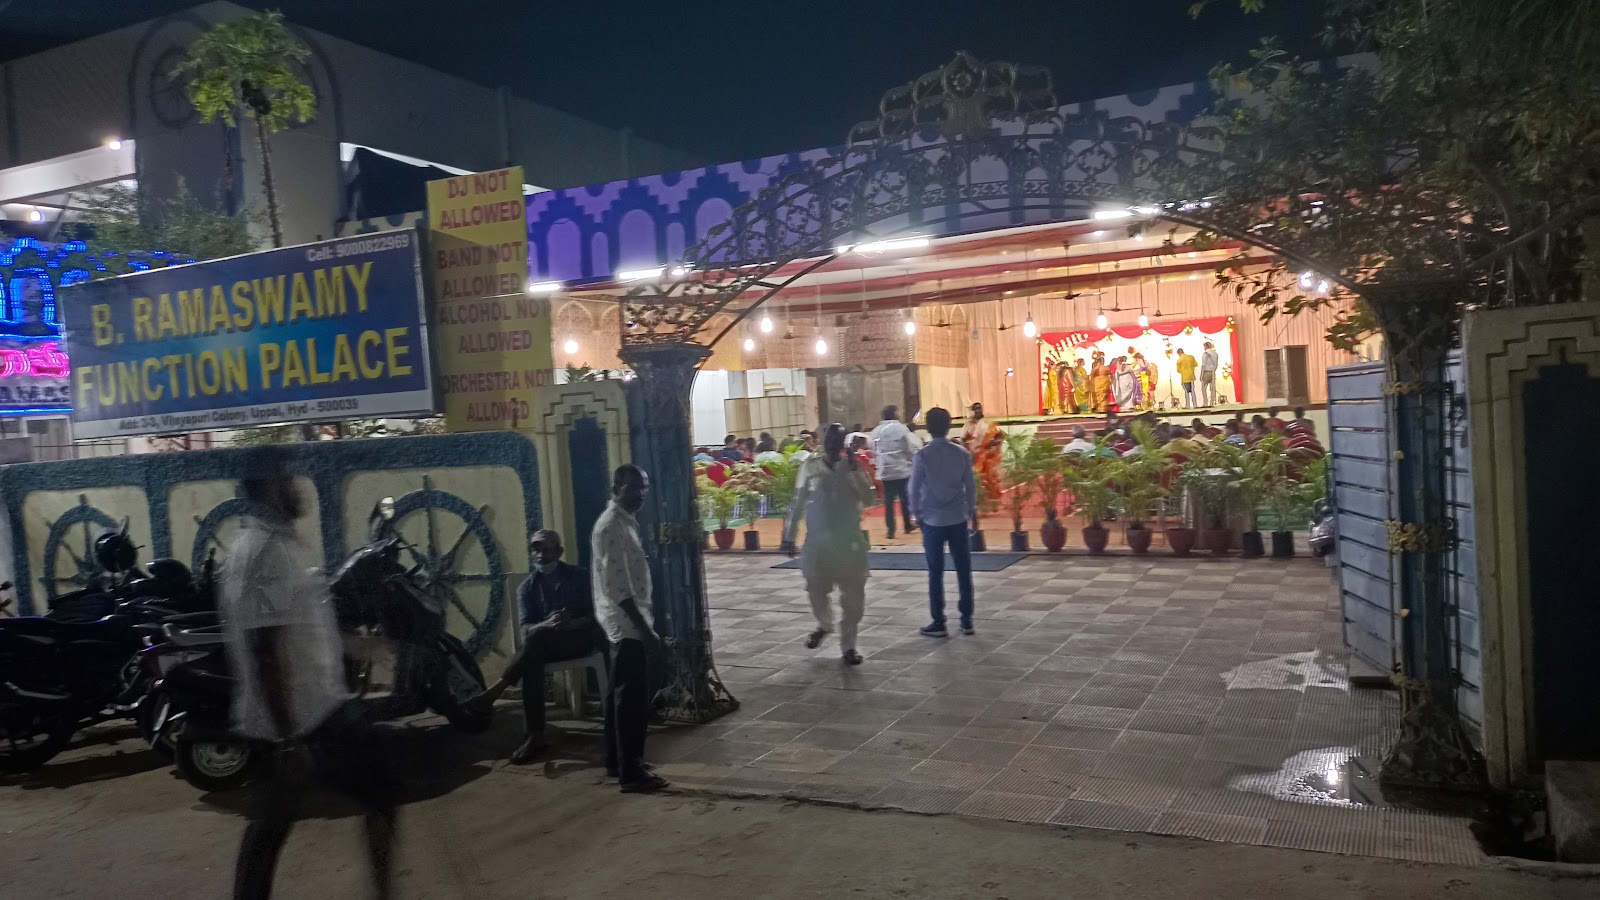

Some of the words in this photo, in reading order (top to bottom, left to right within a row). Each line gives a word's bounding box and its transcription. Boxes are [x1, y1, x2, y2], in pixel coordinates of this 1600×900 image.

[447, 177, 468, 199] DJ
[474, 170, 509, 195] NOT
[440, 199, 522, 230] ALLOWED
[437, 246, 480, 270] BAND
[487, 241, 523, 264] NOT
[441, 273, 521, 299] ALLOWED
[91, 303, 125, 347] B.
[133, 261, 374, 344] RAMASWAMY
[439, 301, 513, 325] ALCOHOL
[516, 298, 550, 319] NOT
[459, 329, 532, 354] ALLOWED
[76, 346, 249, 409] FUNCTION
[259, 327, 413, 390] PALACE
[440, 370, 520, 394] ORCHESTRA
[524, 368, 554, 388] NOT
